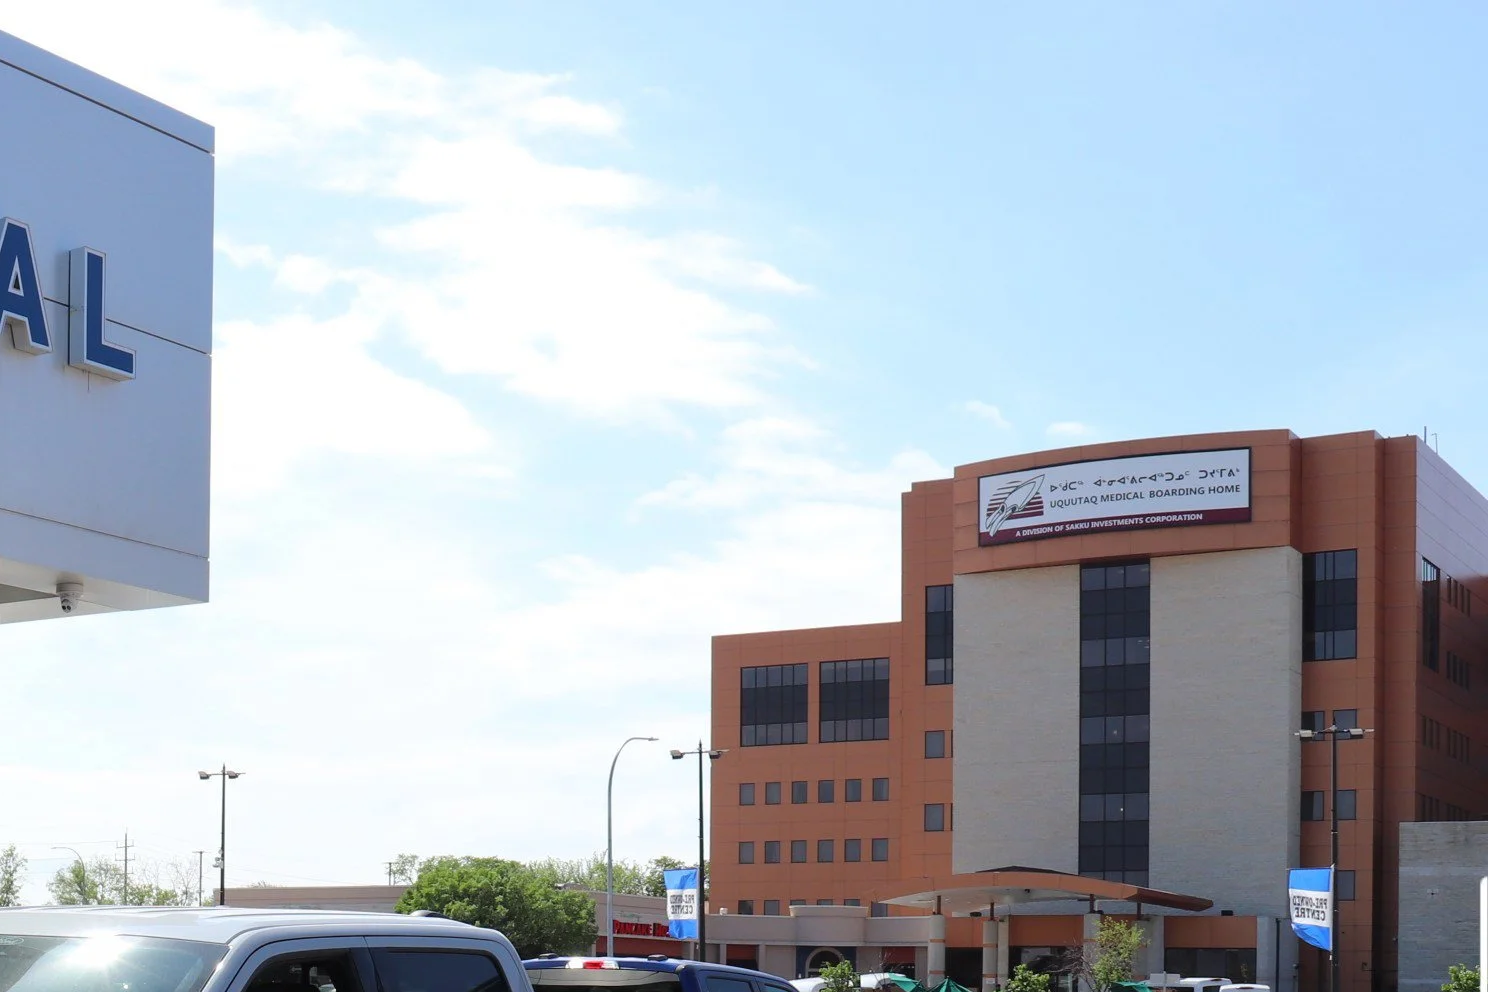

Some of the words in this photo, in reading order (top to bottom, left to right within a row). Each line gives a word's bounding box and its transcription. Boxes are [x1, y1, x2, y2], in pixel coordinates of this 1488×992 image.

[1050, 495, 1098, 508] UQUUTAQ
[1100, 491, 1144, 502] MEDICAL
[1149, 486, 1205, 498] BOARDING
[1208, 484, 1240, 494] HOME
[1022, 526, 1053, 536] DIVISION
[1054, 524, 1064, 532] OF
[1065, 522, 1090, 531] SAKKU
[1091, 517, 1144, 528] INVESTMENTS
[1145, 513, 1203, 524] CORPORATION
